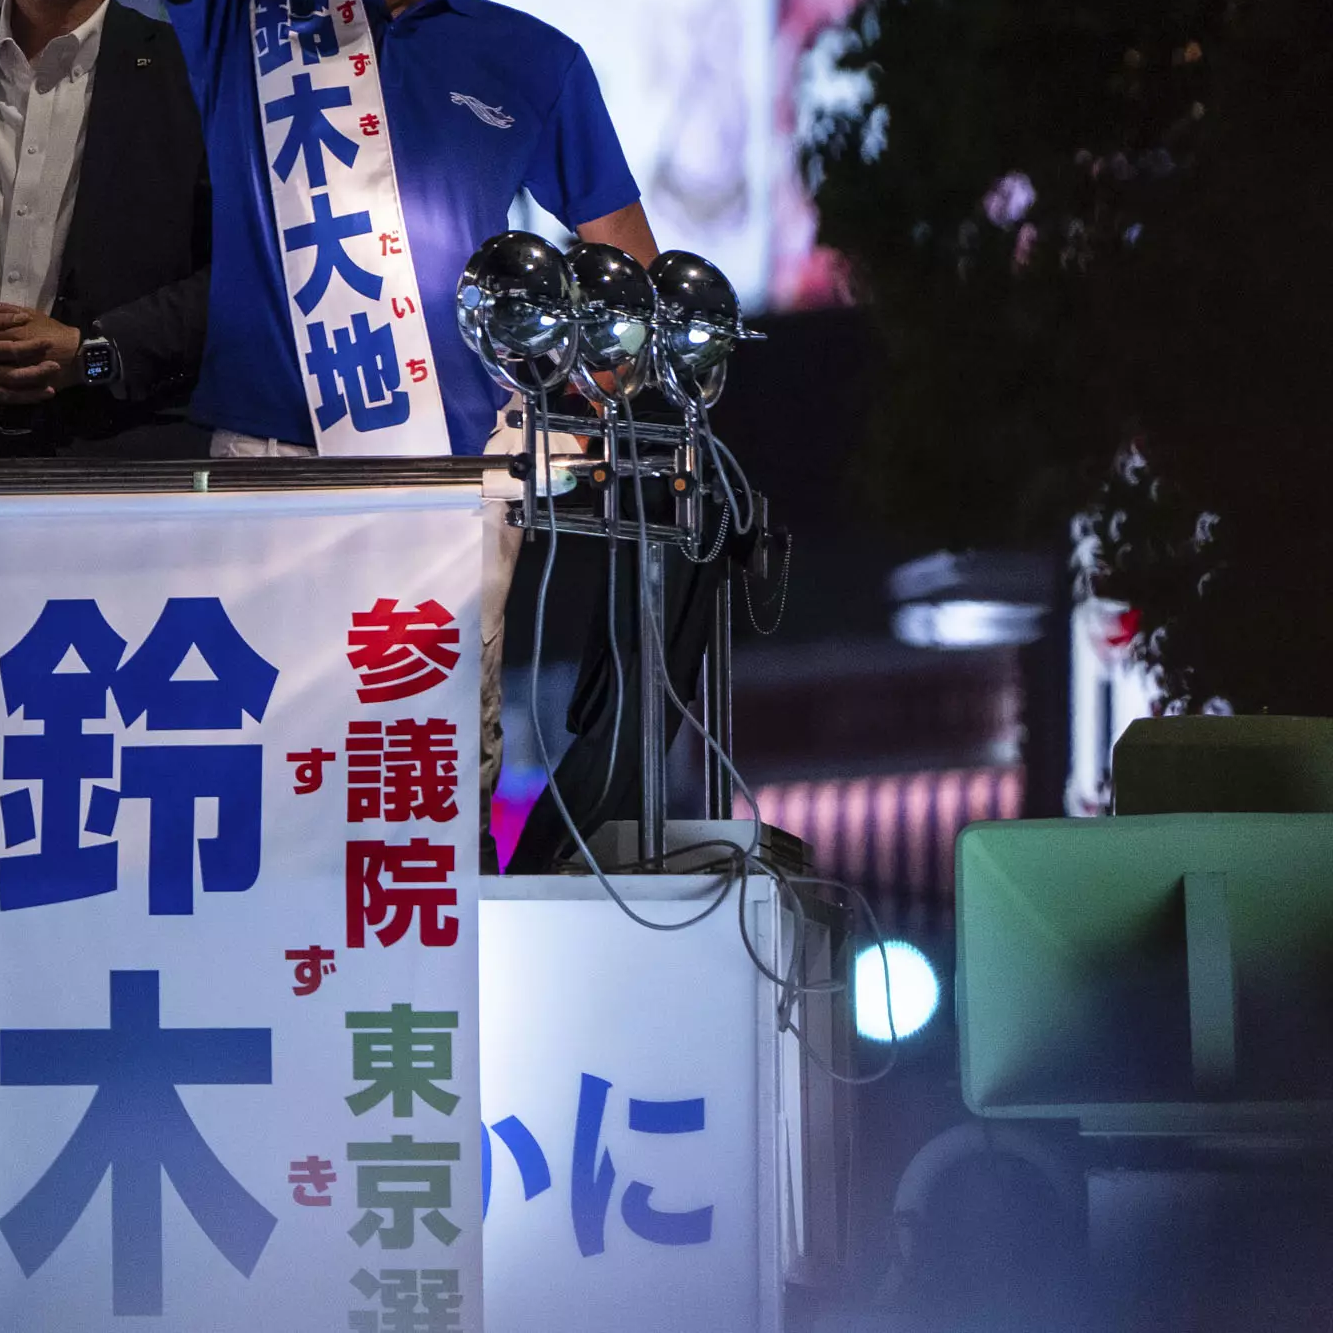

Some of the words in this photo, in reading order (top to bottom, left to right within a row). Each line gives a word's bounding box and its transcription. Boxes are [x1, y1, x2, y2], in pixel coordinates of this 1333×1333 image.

[336, 0, 381, 137] すずき
[378, 230, 429, 383] だいち
[345, 597, 461, 950] 参議院
[284, 747, 338, 1208] すずき
